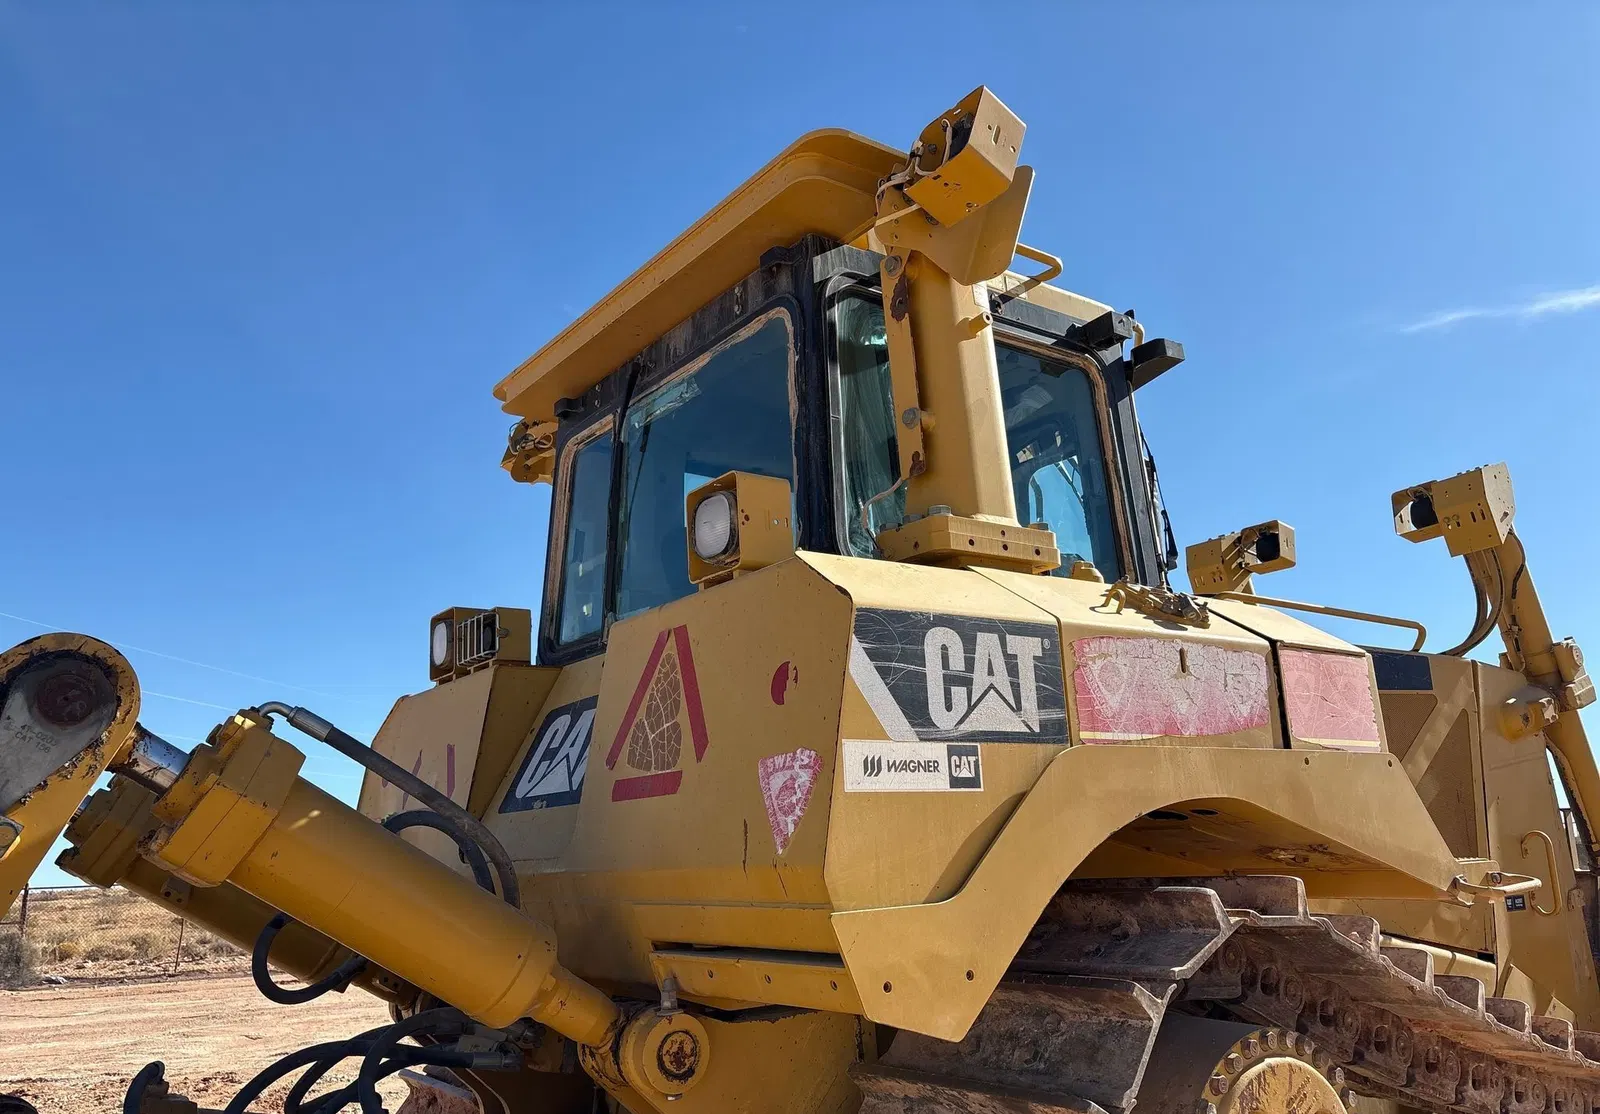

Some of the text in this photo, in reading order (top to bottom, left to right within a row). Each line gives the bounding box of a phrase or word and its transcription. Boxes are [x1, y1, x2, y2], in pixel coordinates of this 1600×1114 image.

[924, 626, 1042, 732] CAT
[887, 755, 978, 778] WAGNER CAT
